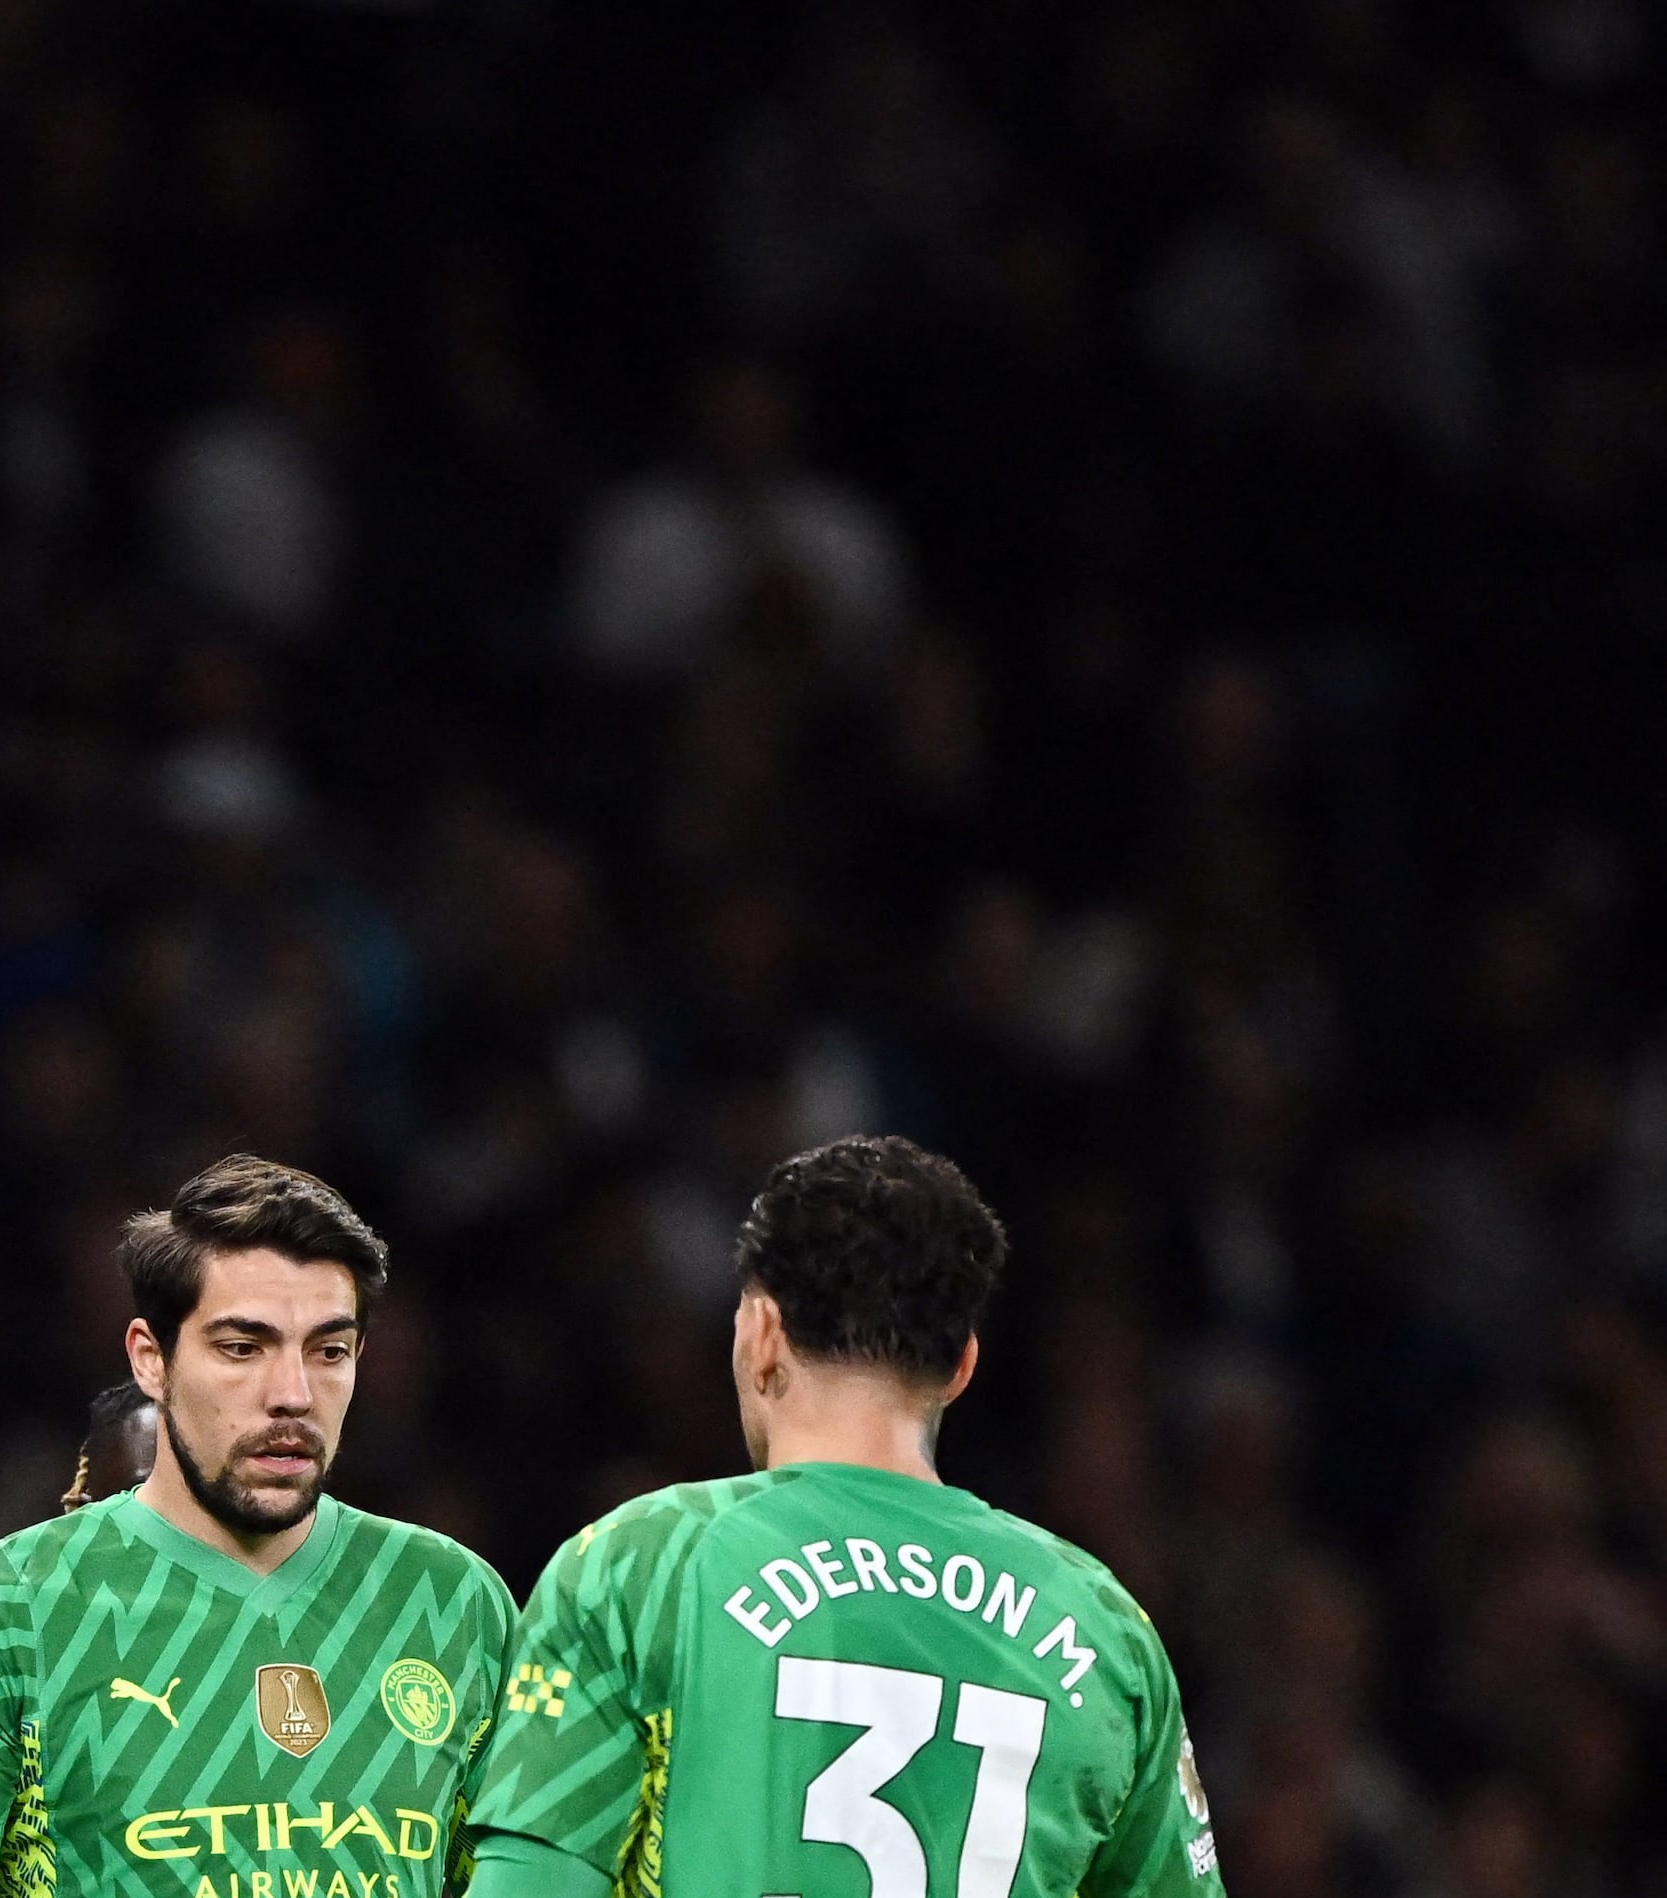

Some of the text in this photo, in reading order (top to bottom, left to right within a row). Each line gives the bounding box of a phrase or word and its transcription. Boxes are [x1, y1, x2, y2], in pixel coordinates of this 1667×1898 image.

[724, 1537, 1098, 1709] EDERSON M.
[387, 1665, 445, 1695] MANCHESTER
[281, 1722, 313, 1734] FIFA
[414, 1728, 434, 1739] CITY
[125, 1801, 439, 1860] ETIHAD
